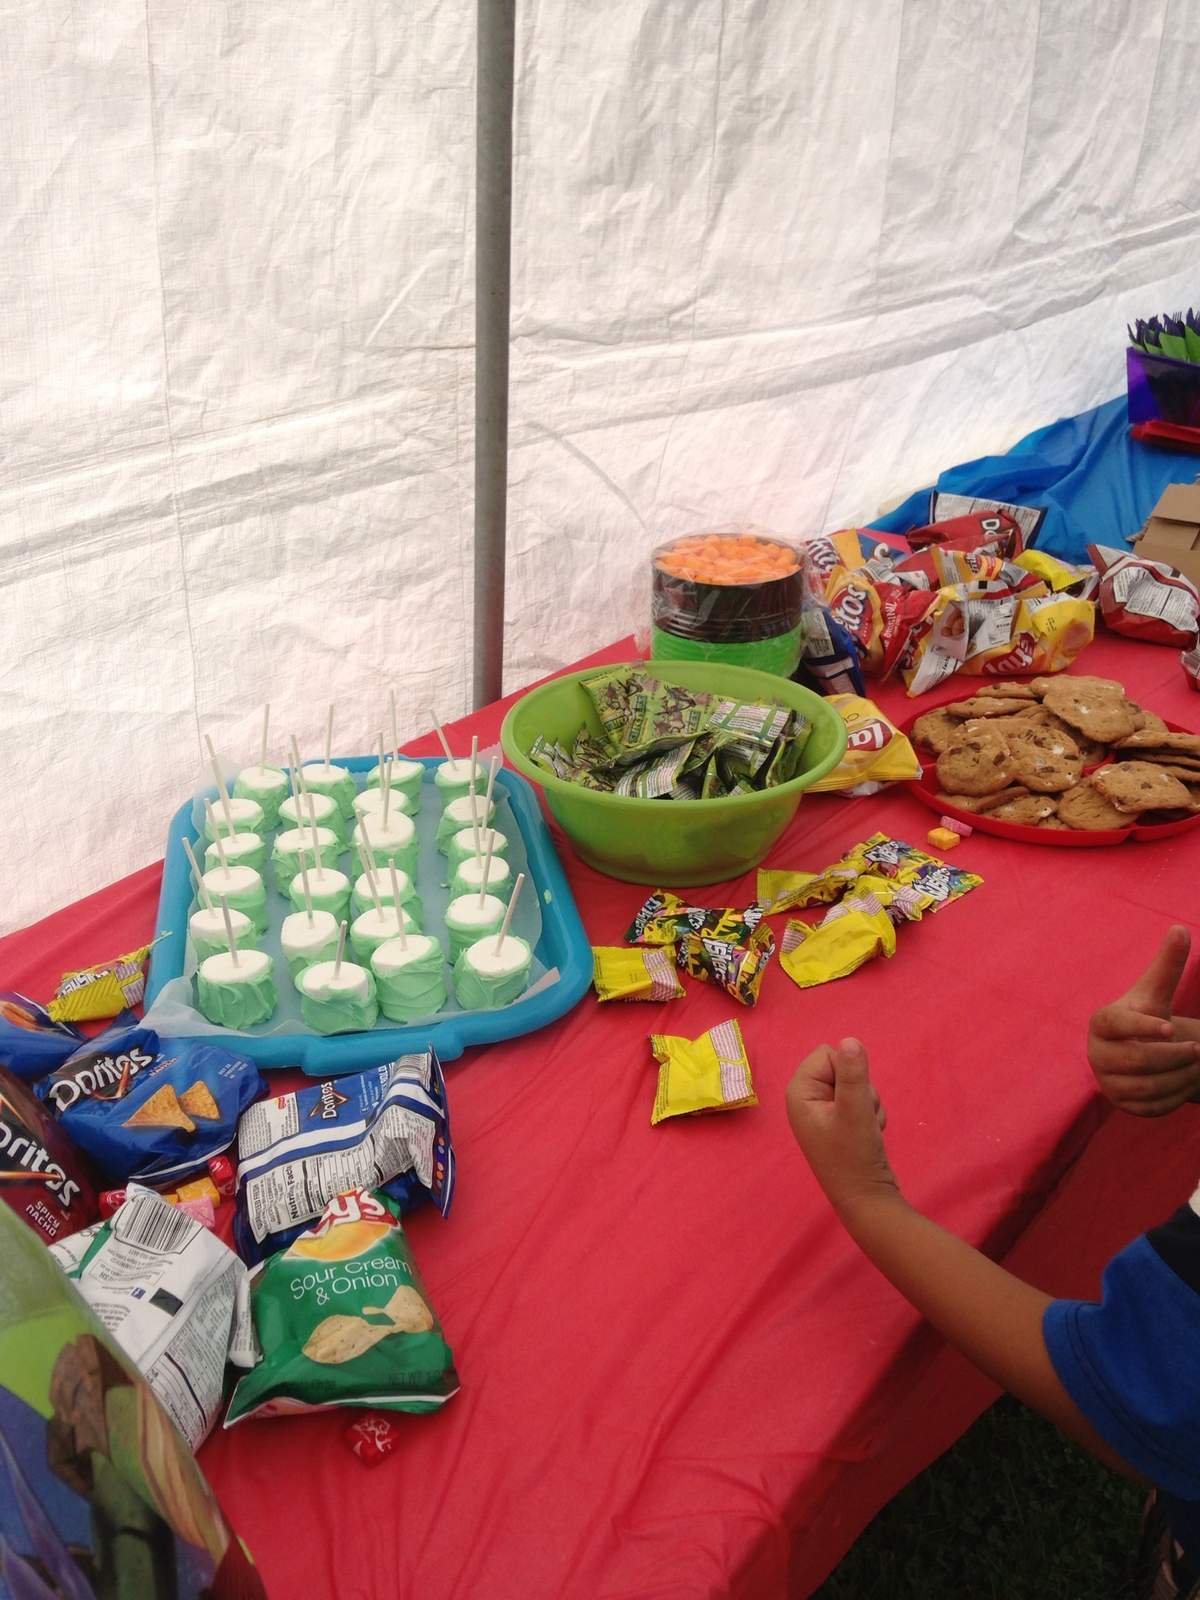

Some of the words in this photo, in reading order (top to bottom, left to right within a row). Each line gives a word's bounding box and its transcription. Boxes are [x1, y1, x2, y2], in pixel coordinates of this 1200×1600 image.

[50, 1048, 152, 1112] Doritos
[322, 1081, 338, 1120] Doritos
[0, 1121, 80, 1207] oritos
[26, 1204, 57, 1237] NACHO
[35, 1200, 60, 1228] SPICY
[327, 1187, 386, 1226] y's
[290, 1266, 337, 1300] Sour
[316, 1288, 330, 1305] &
[332, 1272, 398, 1294] Onion
